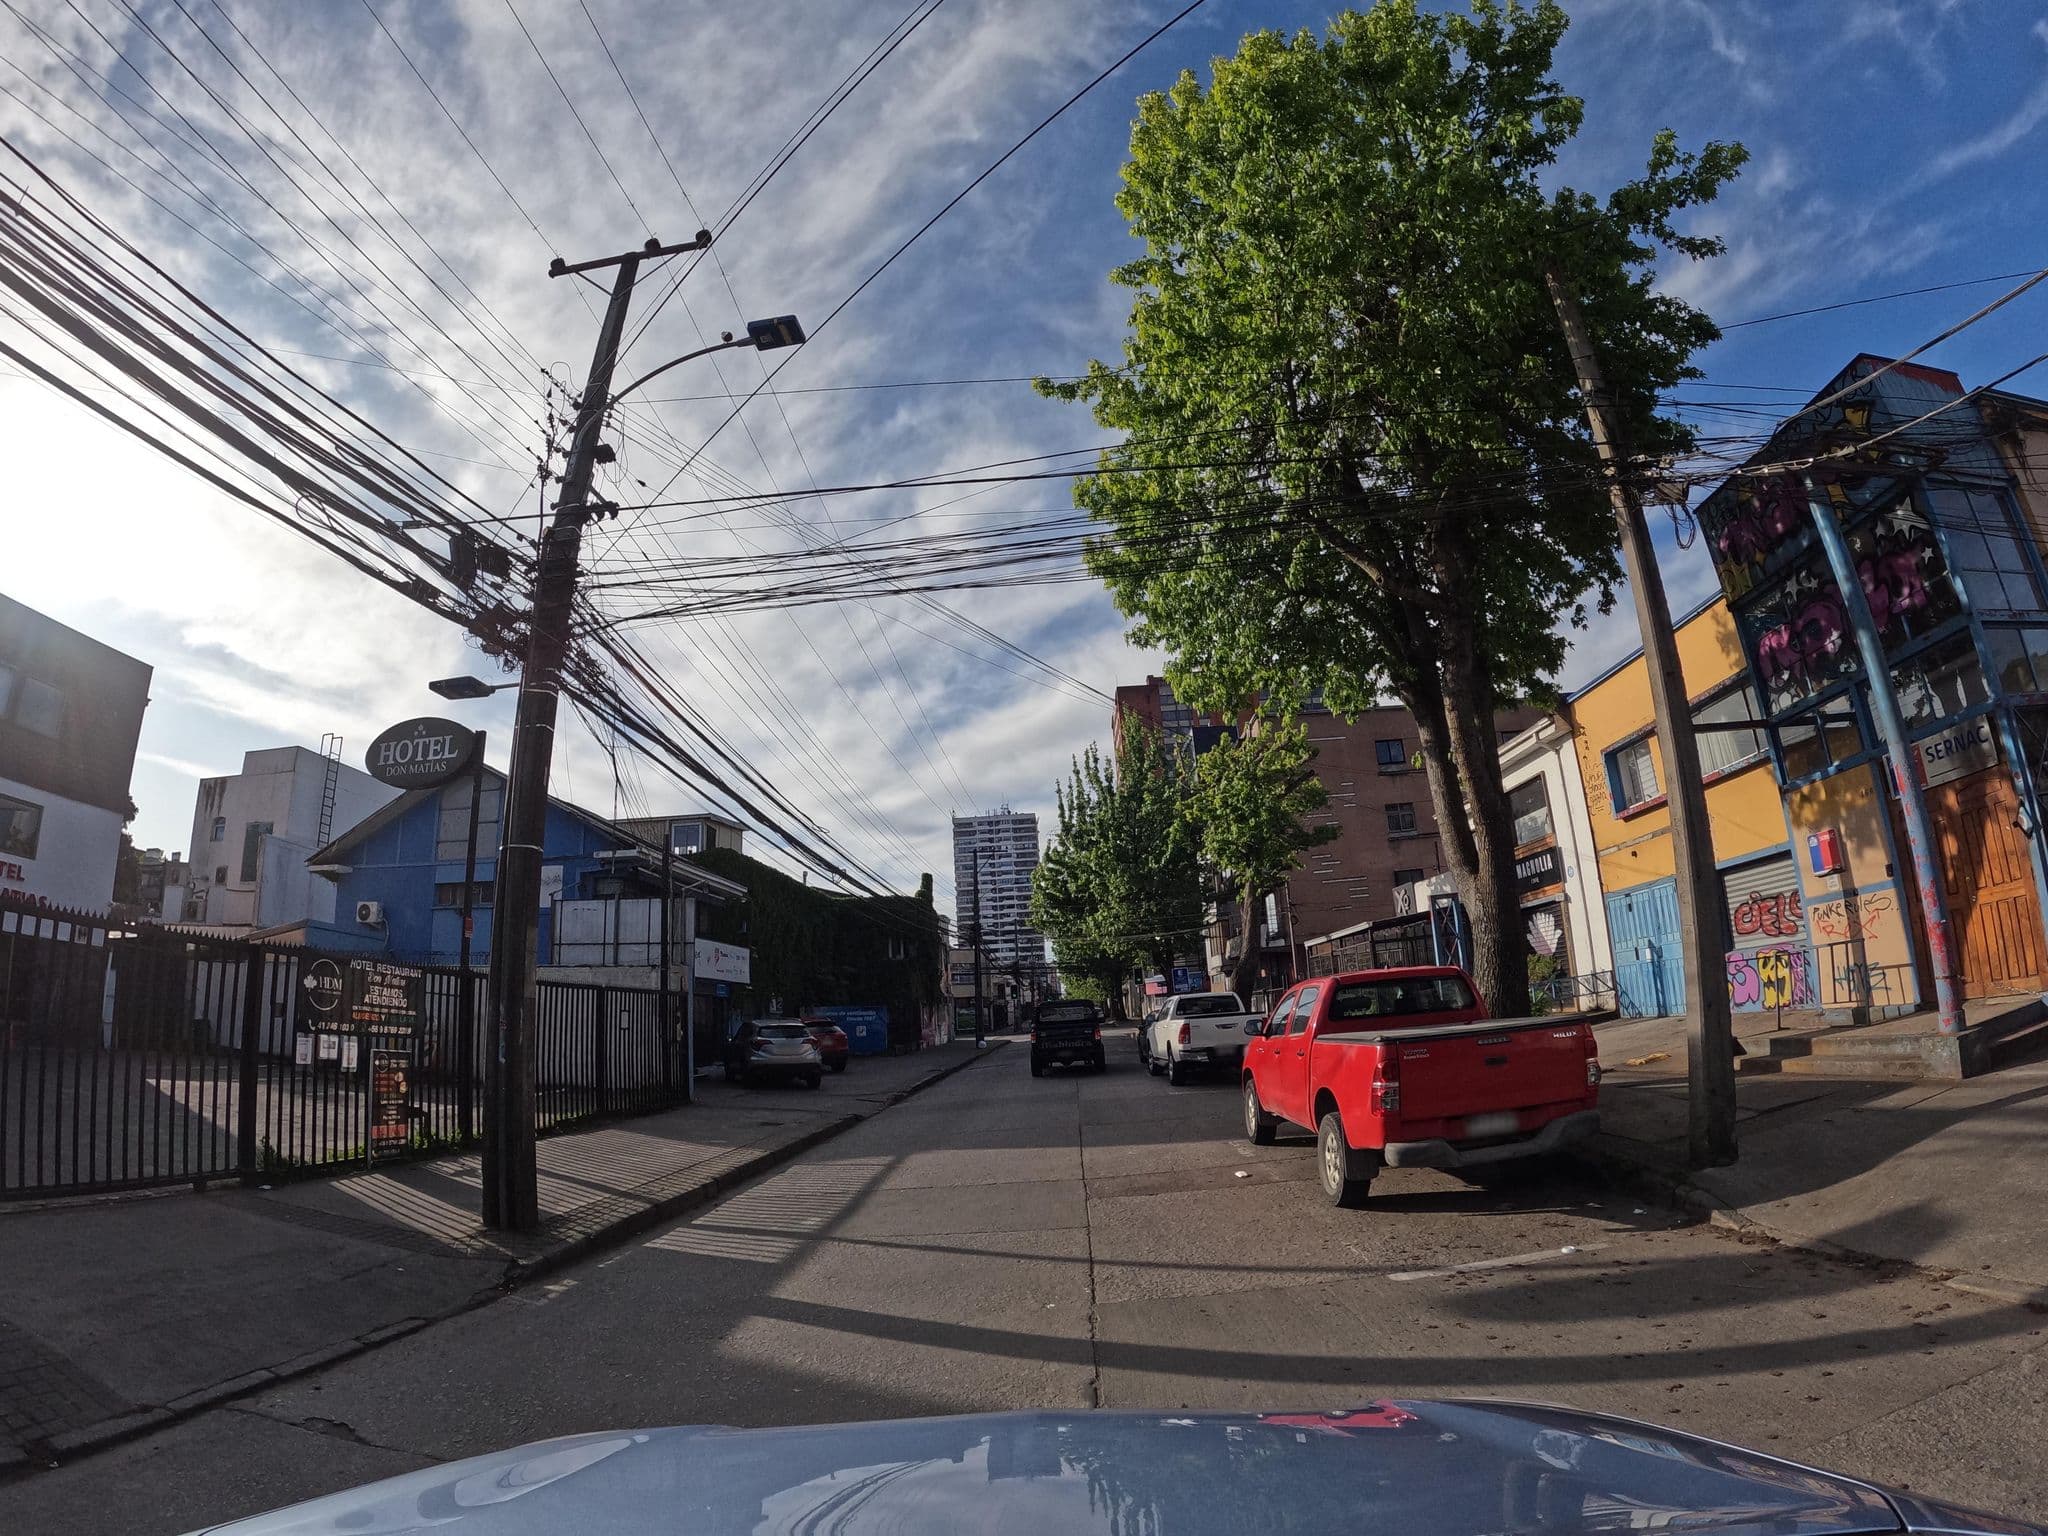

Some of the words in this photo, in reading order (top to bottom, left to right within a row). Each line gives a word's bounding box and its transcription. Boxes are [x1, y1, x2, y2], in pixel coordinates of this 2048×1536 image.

[378, 735, 458, 766] HOTEL
[1925, 725, 1988, 763] SERNAC
[386, 764, 408, 777] DON
[1515, 853, 1553, 879] MAGNOLIA
[350, 959, 375, 971] HOTEL
[376, 963, 423, 978] RESTAURANT
[319, 976, 342, 991] HDM
[369, 985, 403, 998] ESTAMOS
[363, 994, 408, 1007] ATENDIENDO
[1552, 1030, 1577, 1038] HILUX
